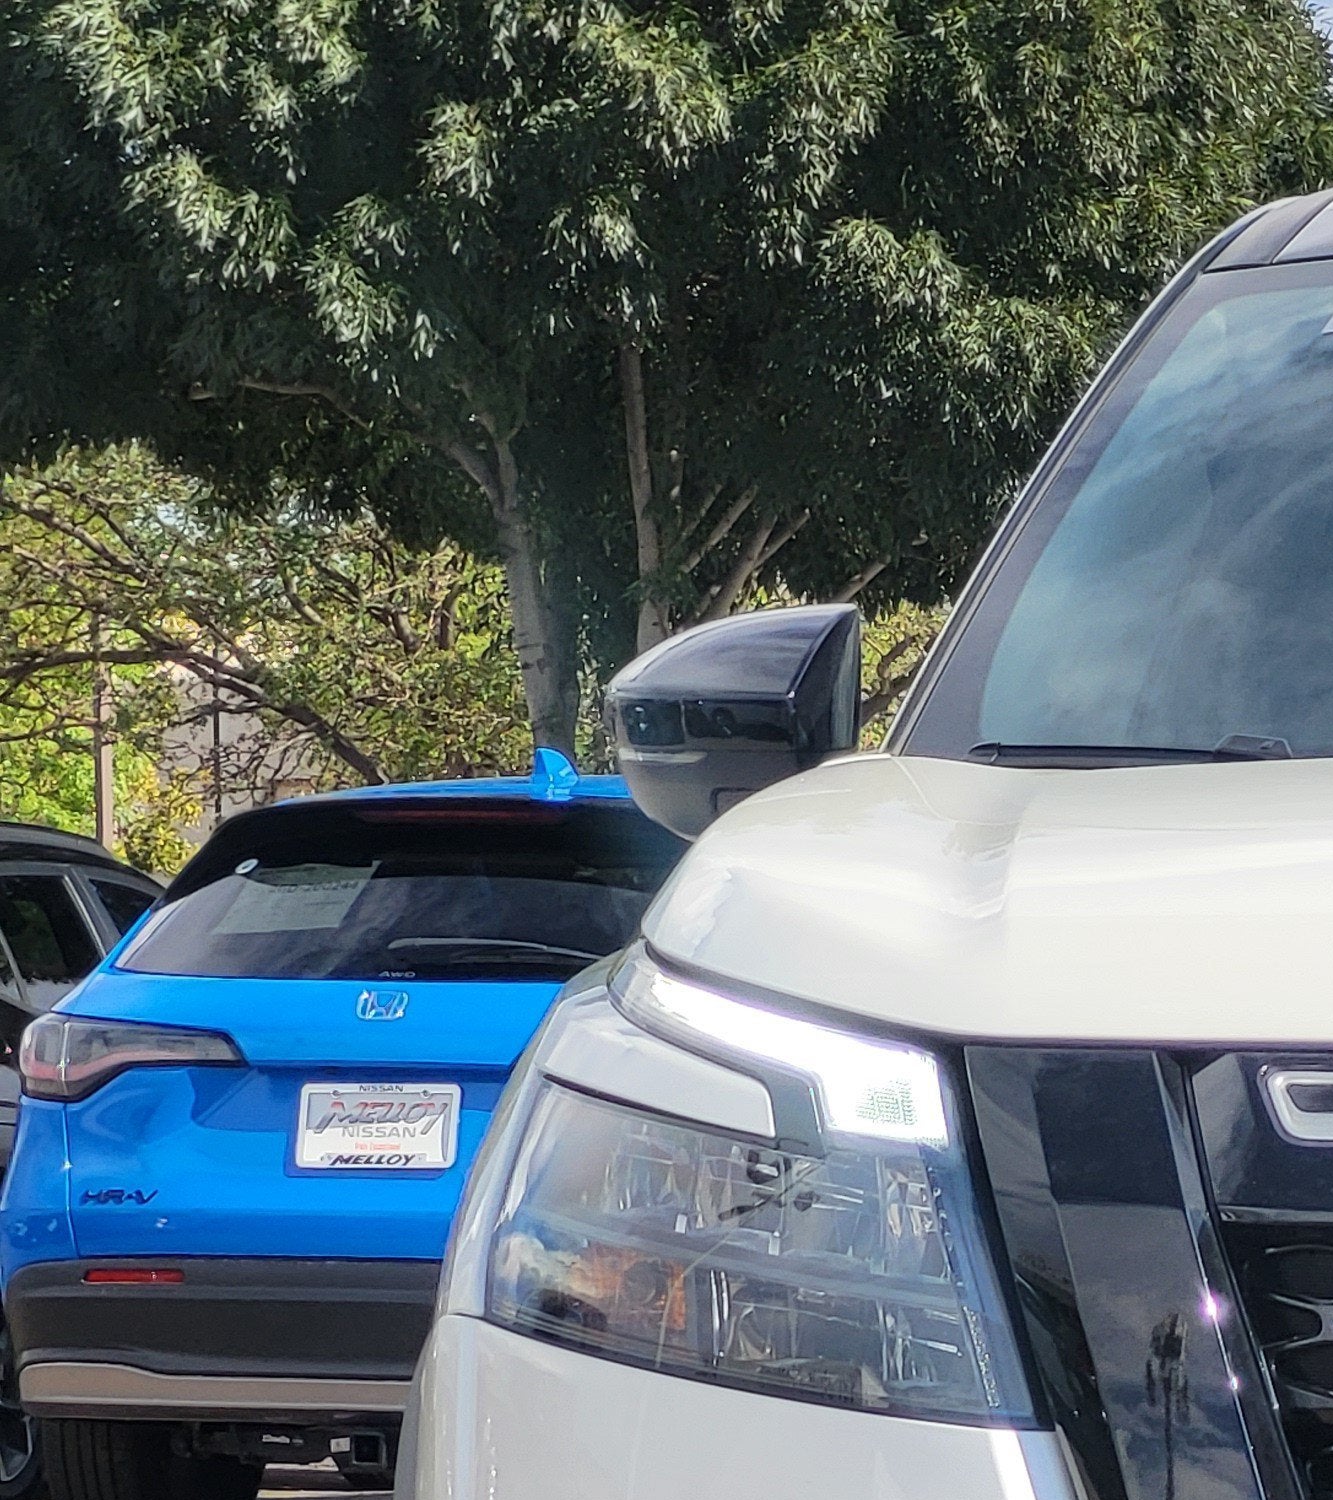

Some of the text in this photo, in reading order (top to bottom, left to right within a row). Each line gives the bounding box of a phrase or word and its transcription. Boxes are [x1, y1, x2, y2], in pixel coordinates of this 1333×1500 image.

[358, 1084, 404, 1092] NISSAN
[313, 1101, 448, 1135] MELLOY
[341, 1126, 416, 1138] NISSAN
[329, 1154, 416, 1166] MELLOY
